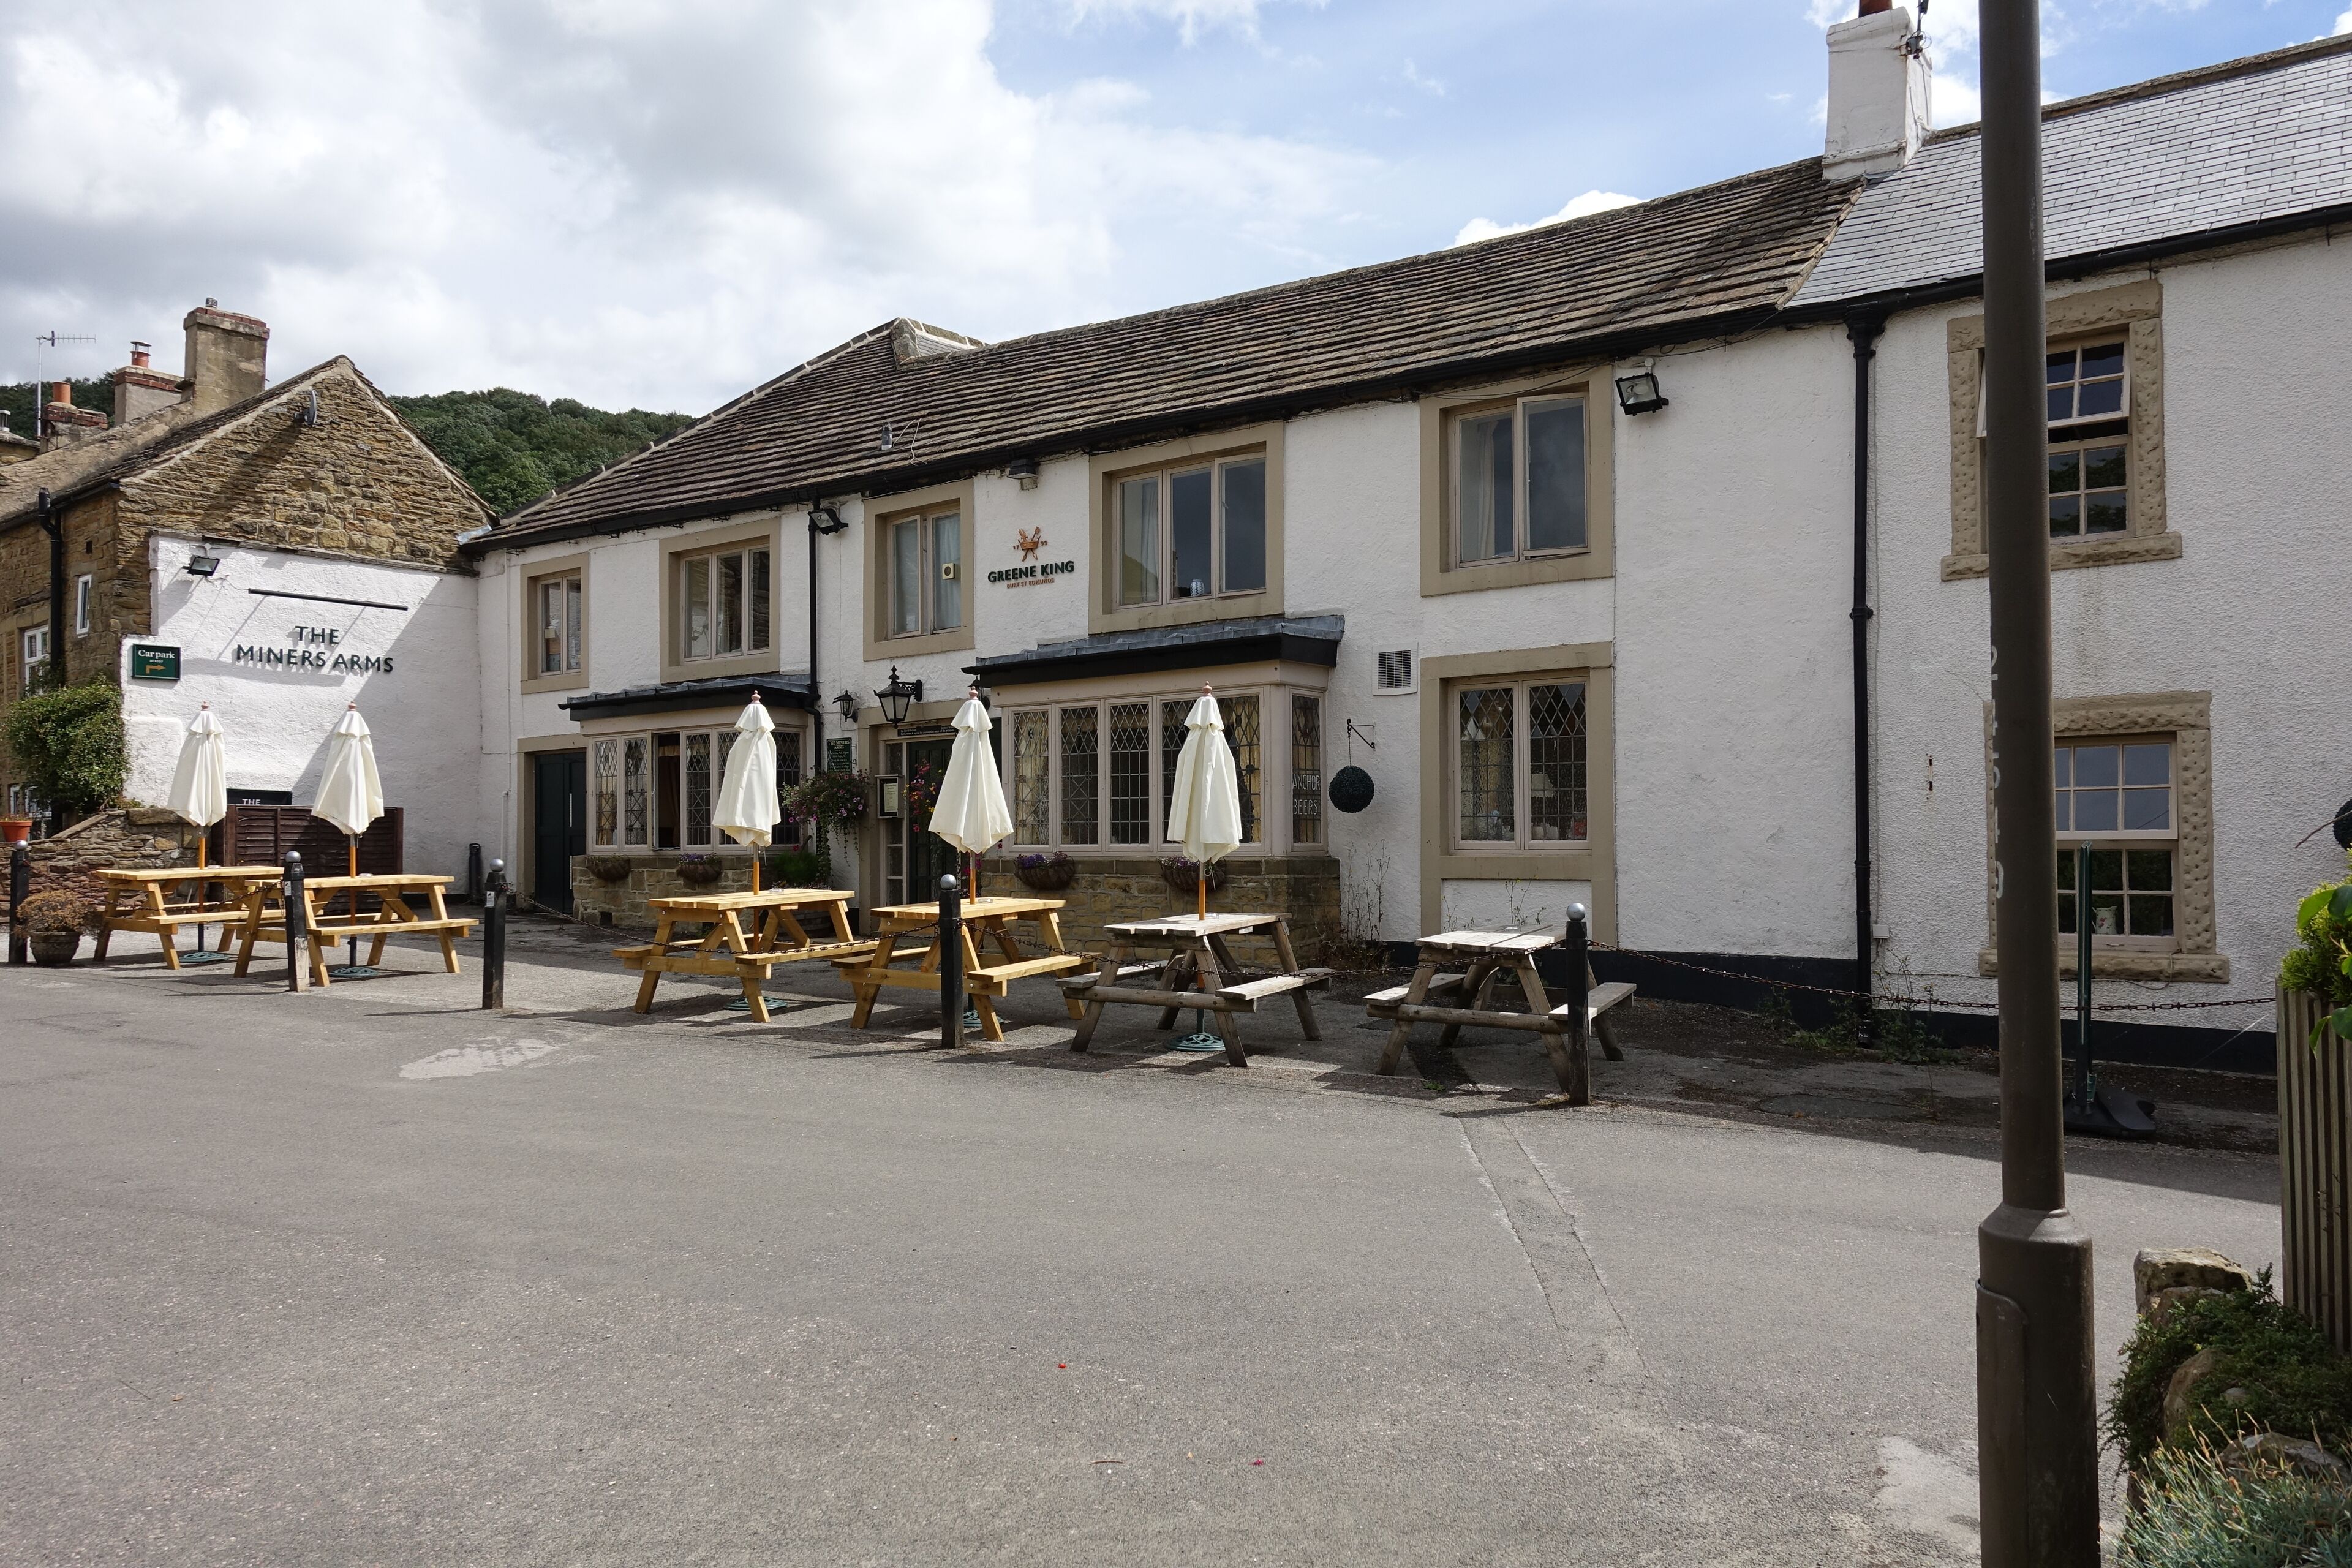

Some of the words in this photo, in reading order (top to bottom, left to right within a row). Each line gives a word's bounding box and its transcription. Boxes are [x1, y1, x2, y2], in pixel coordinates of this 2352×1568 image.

[987, 565, 1037, 582] GREENE
[1041, 560, 1075, 576] KING
[1028, 578, 1055, 586] EDMUNDS
[295, 625, 340, 644] THE
[236, 644, 326, 668] MINERS
[333, 653, 394, 673] ARMS
[1292, 774, 1321, 790] ANCHOR
